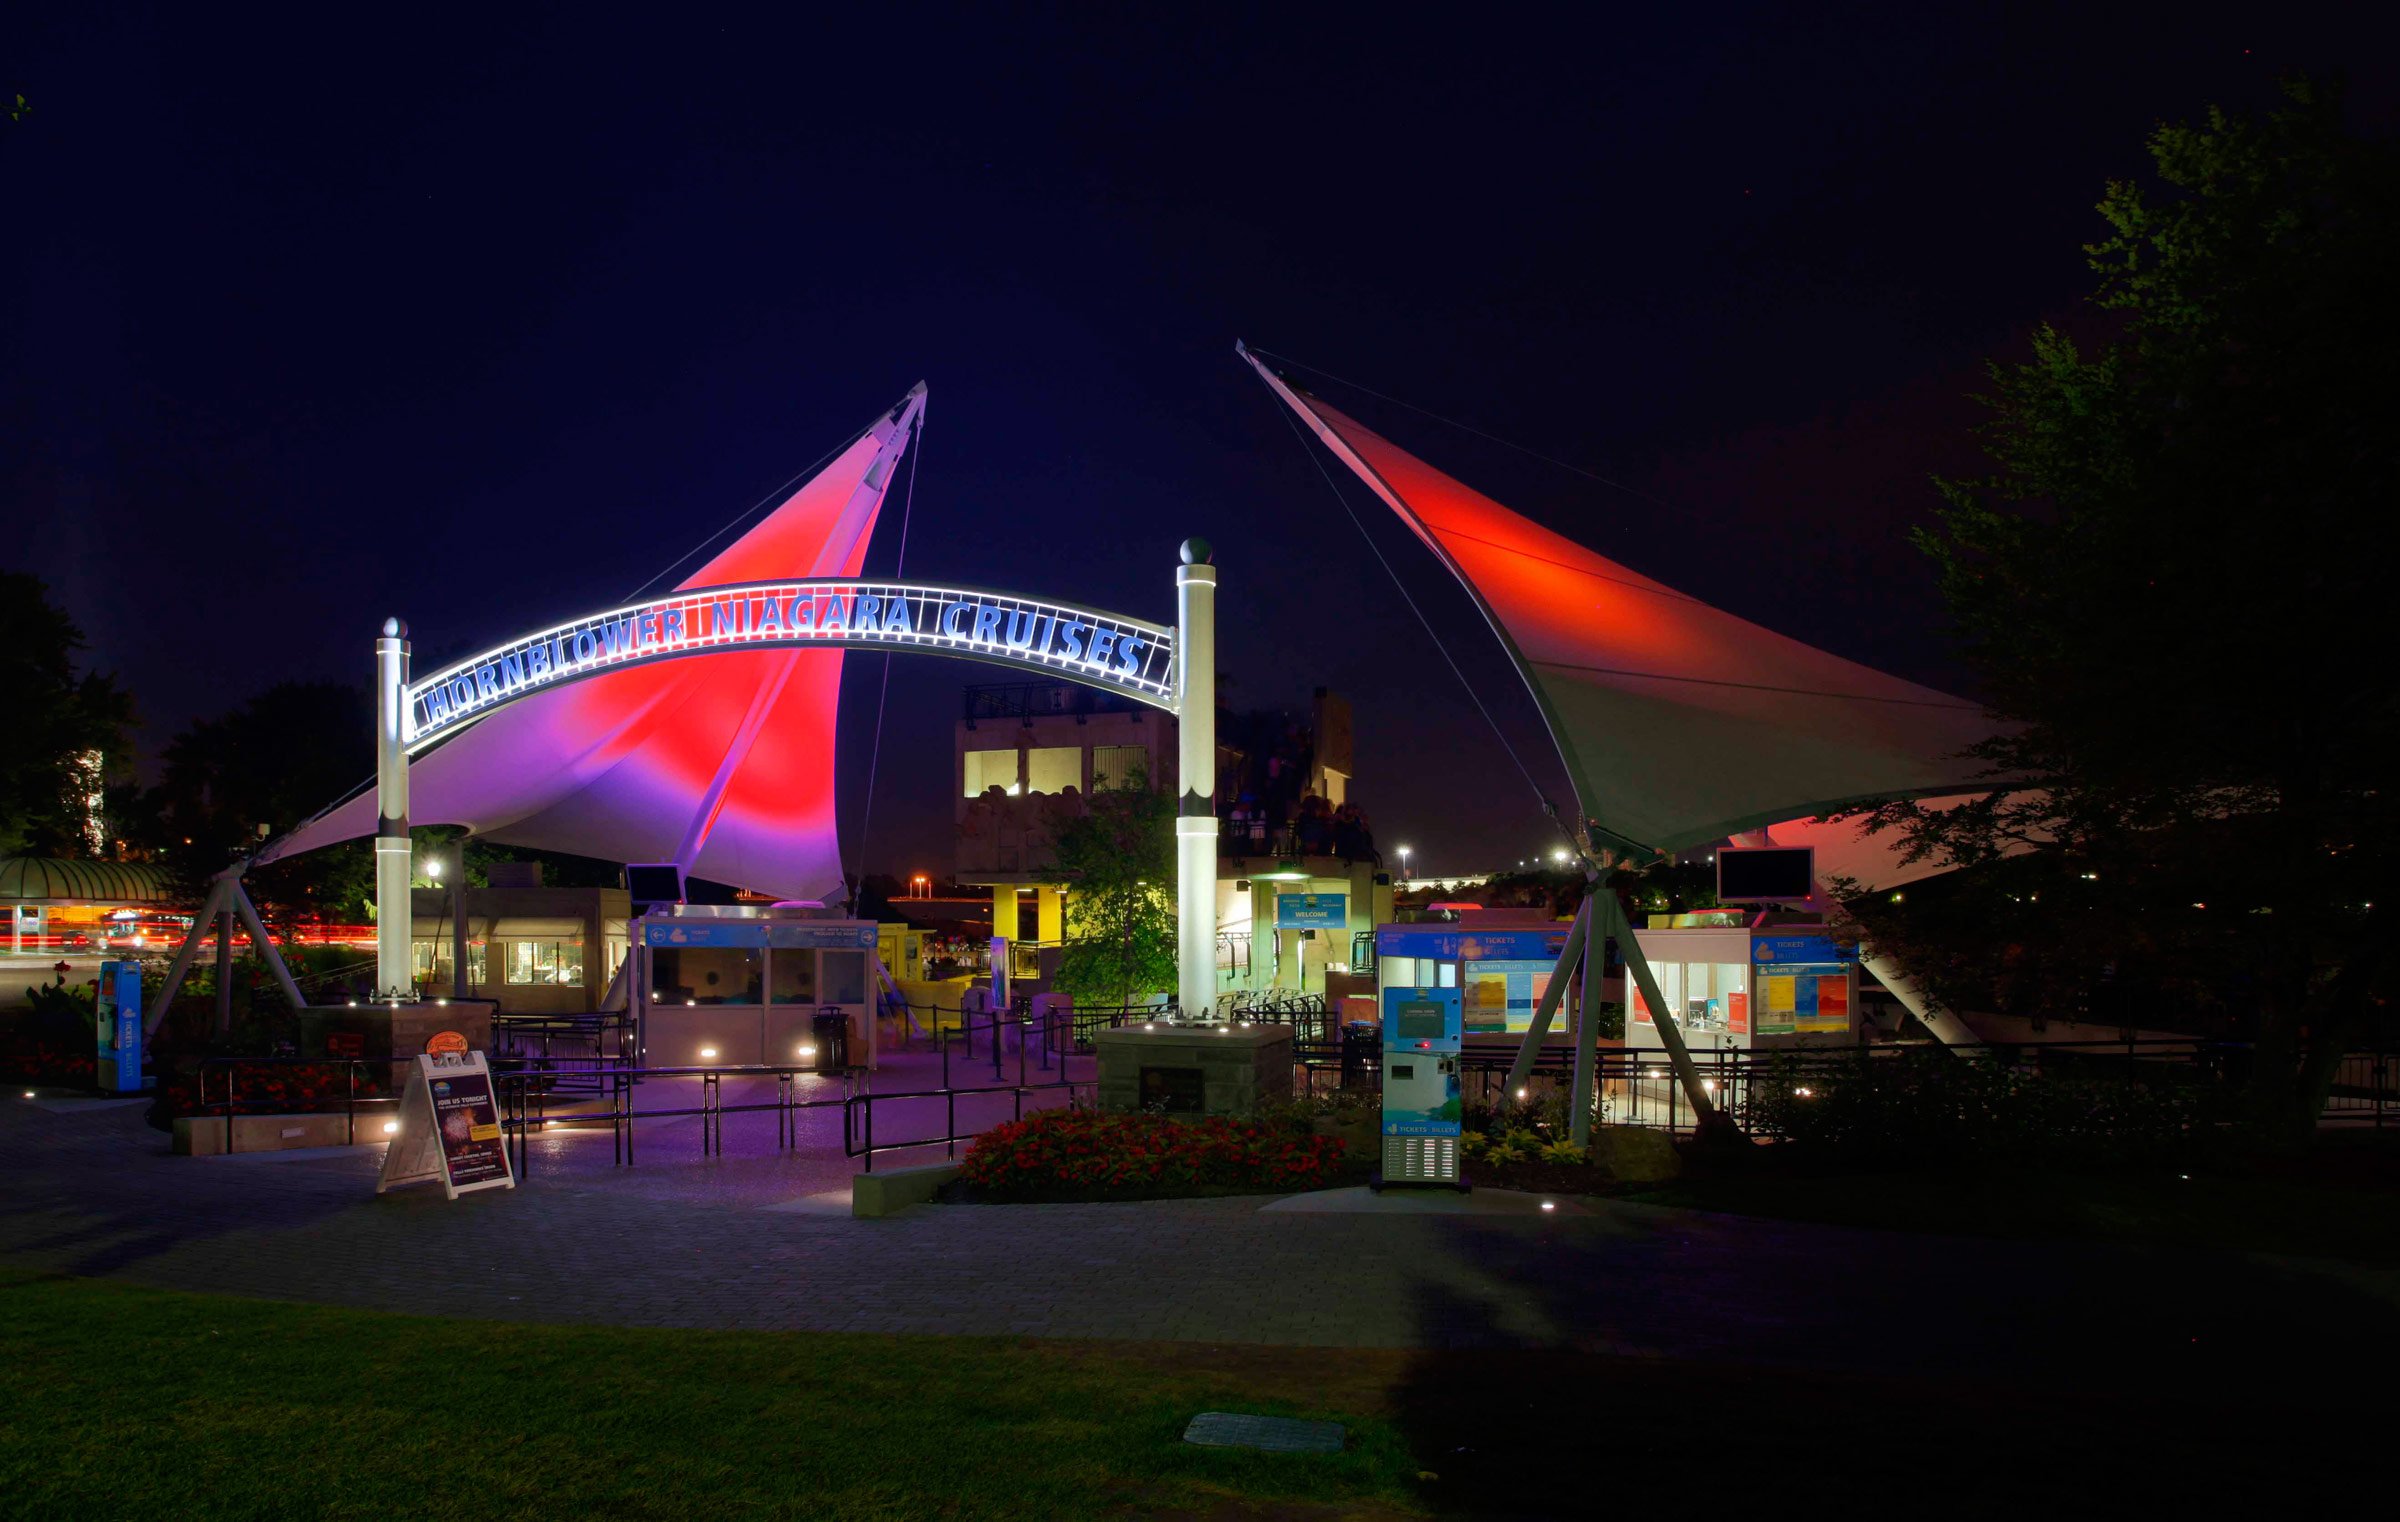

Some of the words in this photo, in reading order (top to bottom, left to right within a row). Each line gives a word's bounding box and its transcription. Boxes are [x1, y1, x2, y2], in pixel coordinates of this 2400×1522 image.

[426, 608, 684, 723] HORNBLOWER
[711, 594, 912, 638] NIAGARA
[943, 601, 1145, 678] CRUISES
[125, 1020, 133, 1048] TICKETS
[438, 1098, 451, 1106] JOIN
[461, 1095, 488, 1103] TONIGHT
